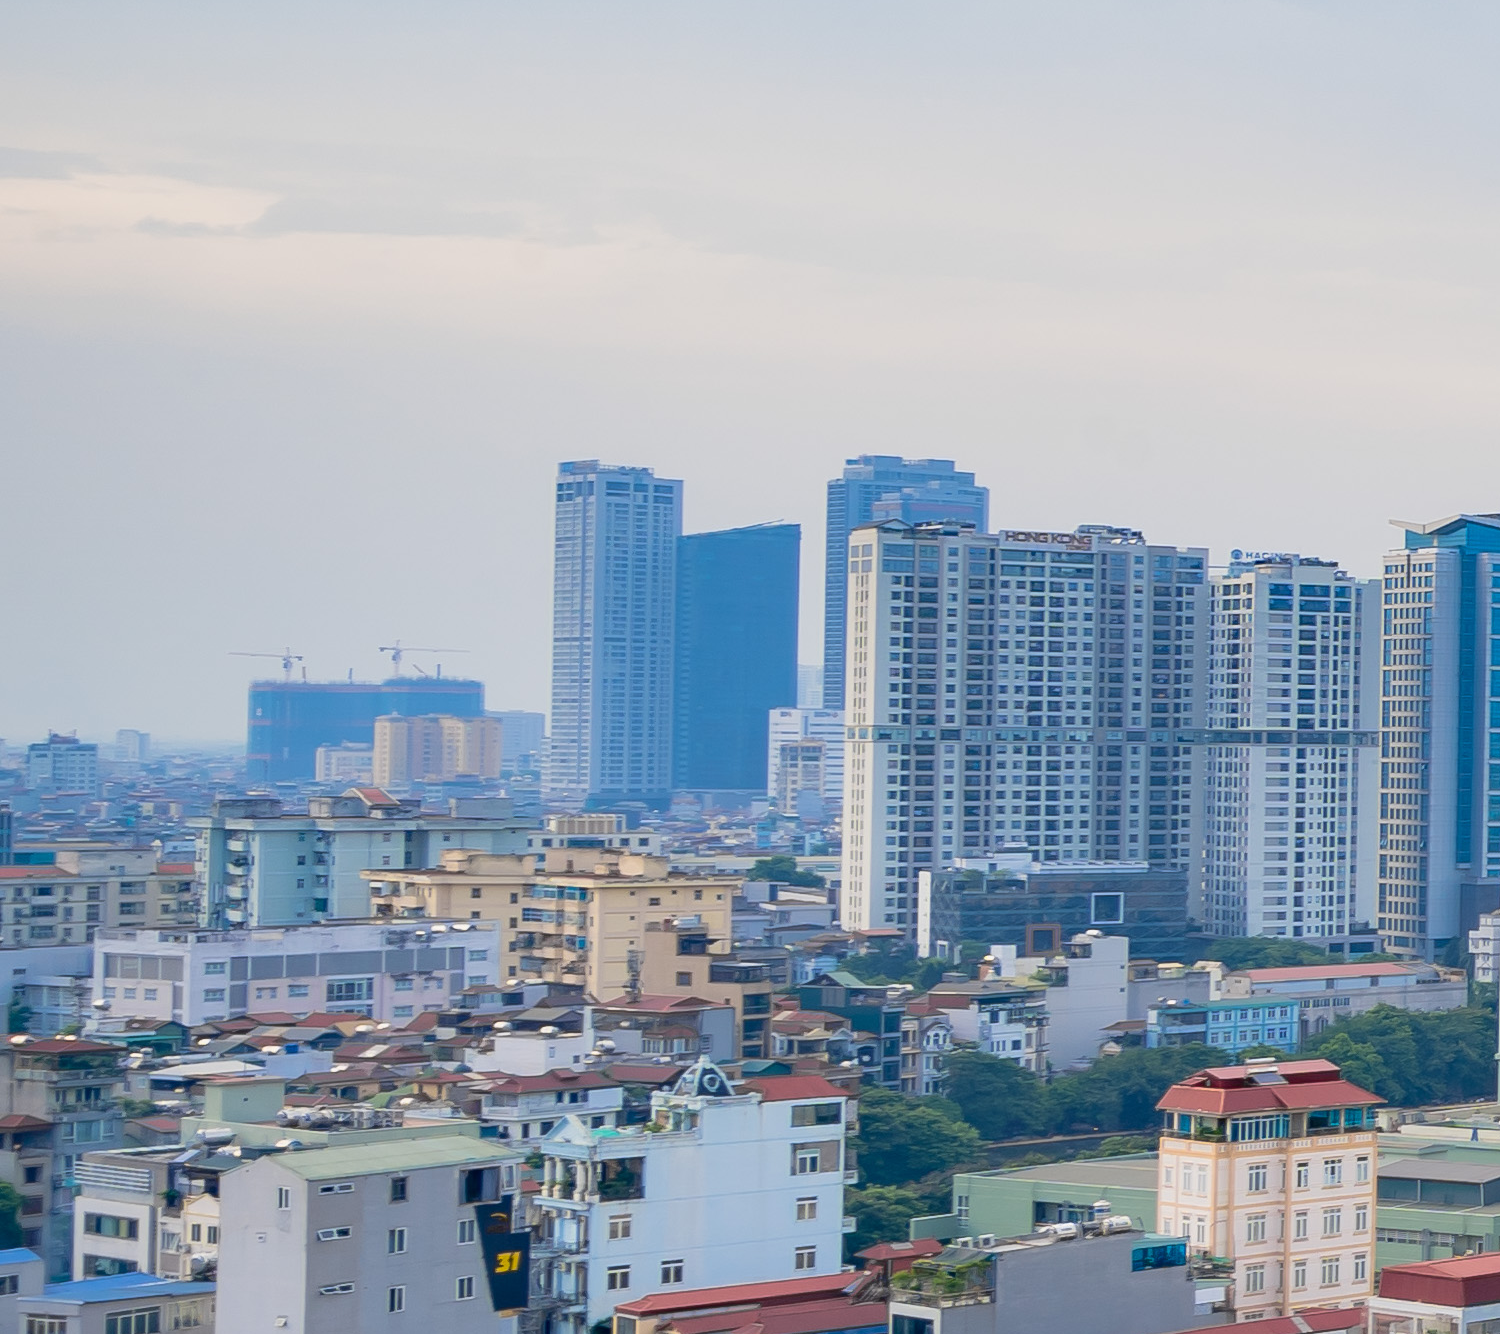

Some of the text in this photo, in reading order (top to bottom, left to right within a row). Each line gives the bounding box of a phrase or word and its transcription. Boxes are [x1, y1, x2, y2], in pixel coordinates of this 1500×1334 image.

[1005, 532, 1092, 545] HONG KONG
[495, 1251, 521, 1273] 31
